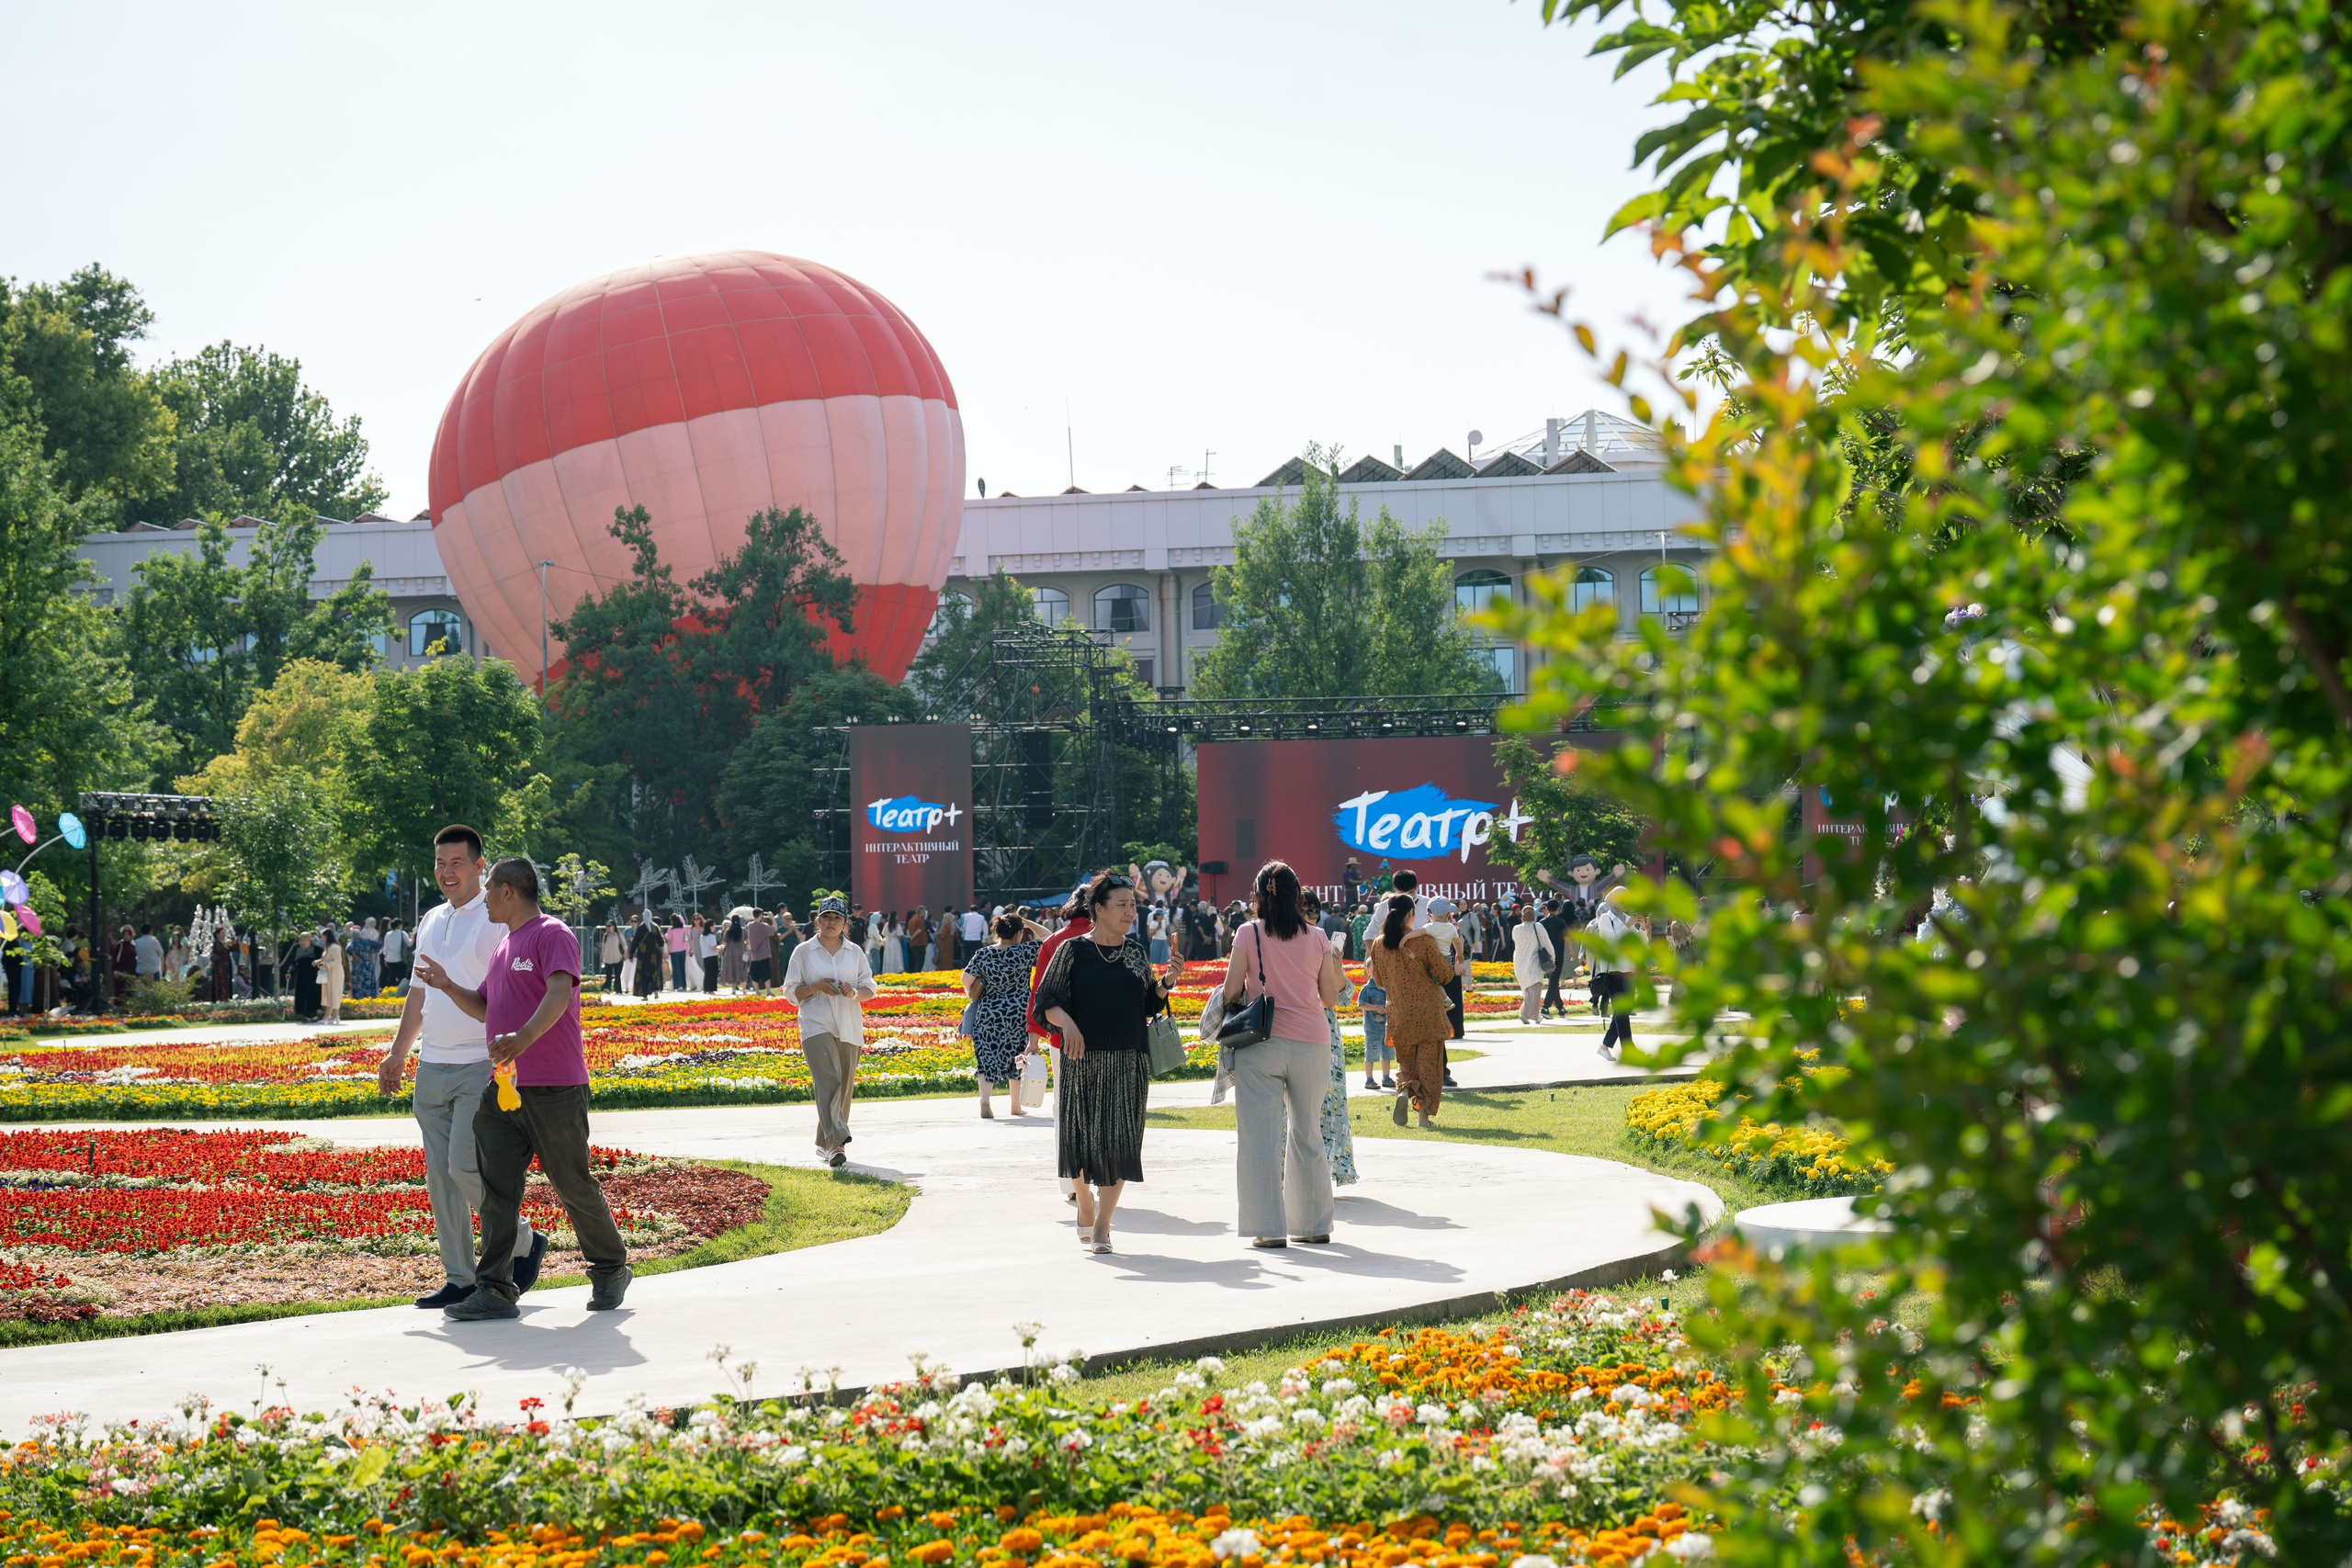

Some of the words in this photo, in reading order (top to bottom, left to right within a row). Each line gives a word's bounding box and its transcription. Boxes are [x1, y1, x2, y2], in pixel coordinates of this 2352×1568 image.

[867, 797, 963, 835] Театр+
[1339, 790, 1535, 864] Театр+
[865, 840, 959, 852] ИНТЕРАКТИВНЫЙ
[895, 853, 930, 863] ТЕАТР
[1492, 882, 1553, 899] ТЕА
